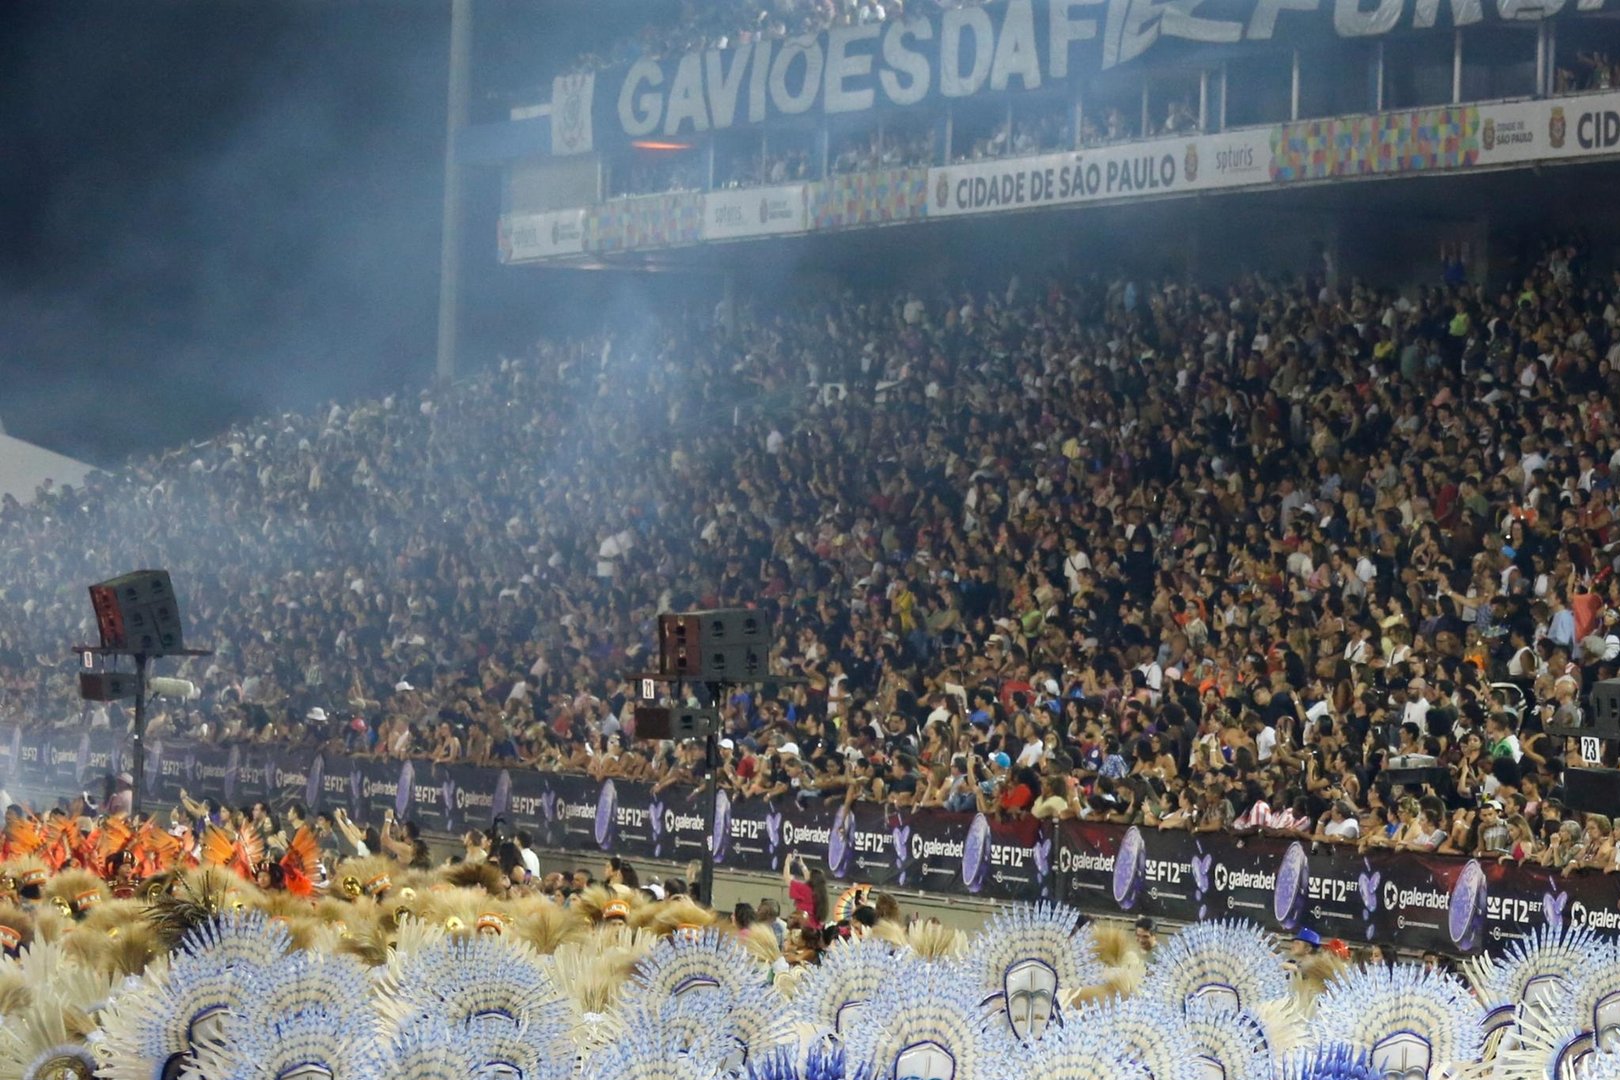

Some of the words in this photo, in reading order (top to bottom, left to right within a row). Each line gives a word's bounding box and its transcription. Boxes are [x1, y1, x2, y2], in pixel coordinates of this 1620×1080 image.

[1512, 131, 1533, 143] PAULO
[1216, 145, 1253, 175] spturis
[956, 172, 1025, 209] CIDADE
[1031, 168, 1054, 201] DE
[1059, 156, 1100, 196] SÃO
[1106, 153, 1175, 190] PAULO
[1583, 738, 1597, 761] 23
[520, 797, 536, 815] F12
[625, 808, 643, 827] F12
[740, 819, 759, 839] F12
[793, 821, 831, 844] galerabet
[865, 833, 884, 853] F12
[923, 834, 964, 858] galerabet
[1001, 846, 1024, 868] F12
[1071, 852, 1115, 872] galerabet
[1157, 861, 1181, 884] F12
[1228, 868, 1276, 891] galerabet
[1321, 878, 1347, 903] F12
[1399, 887, 1450, 911] galerabet
[1501, 898, 1530, 923] F12
